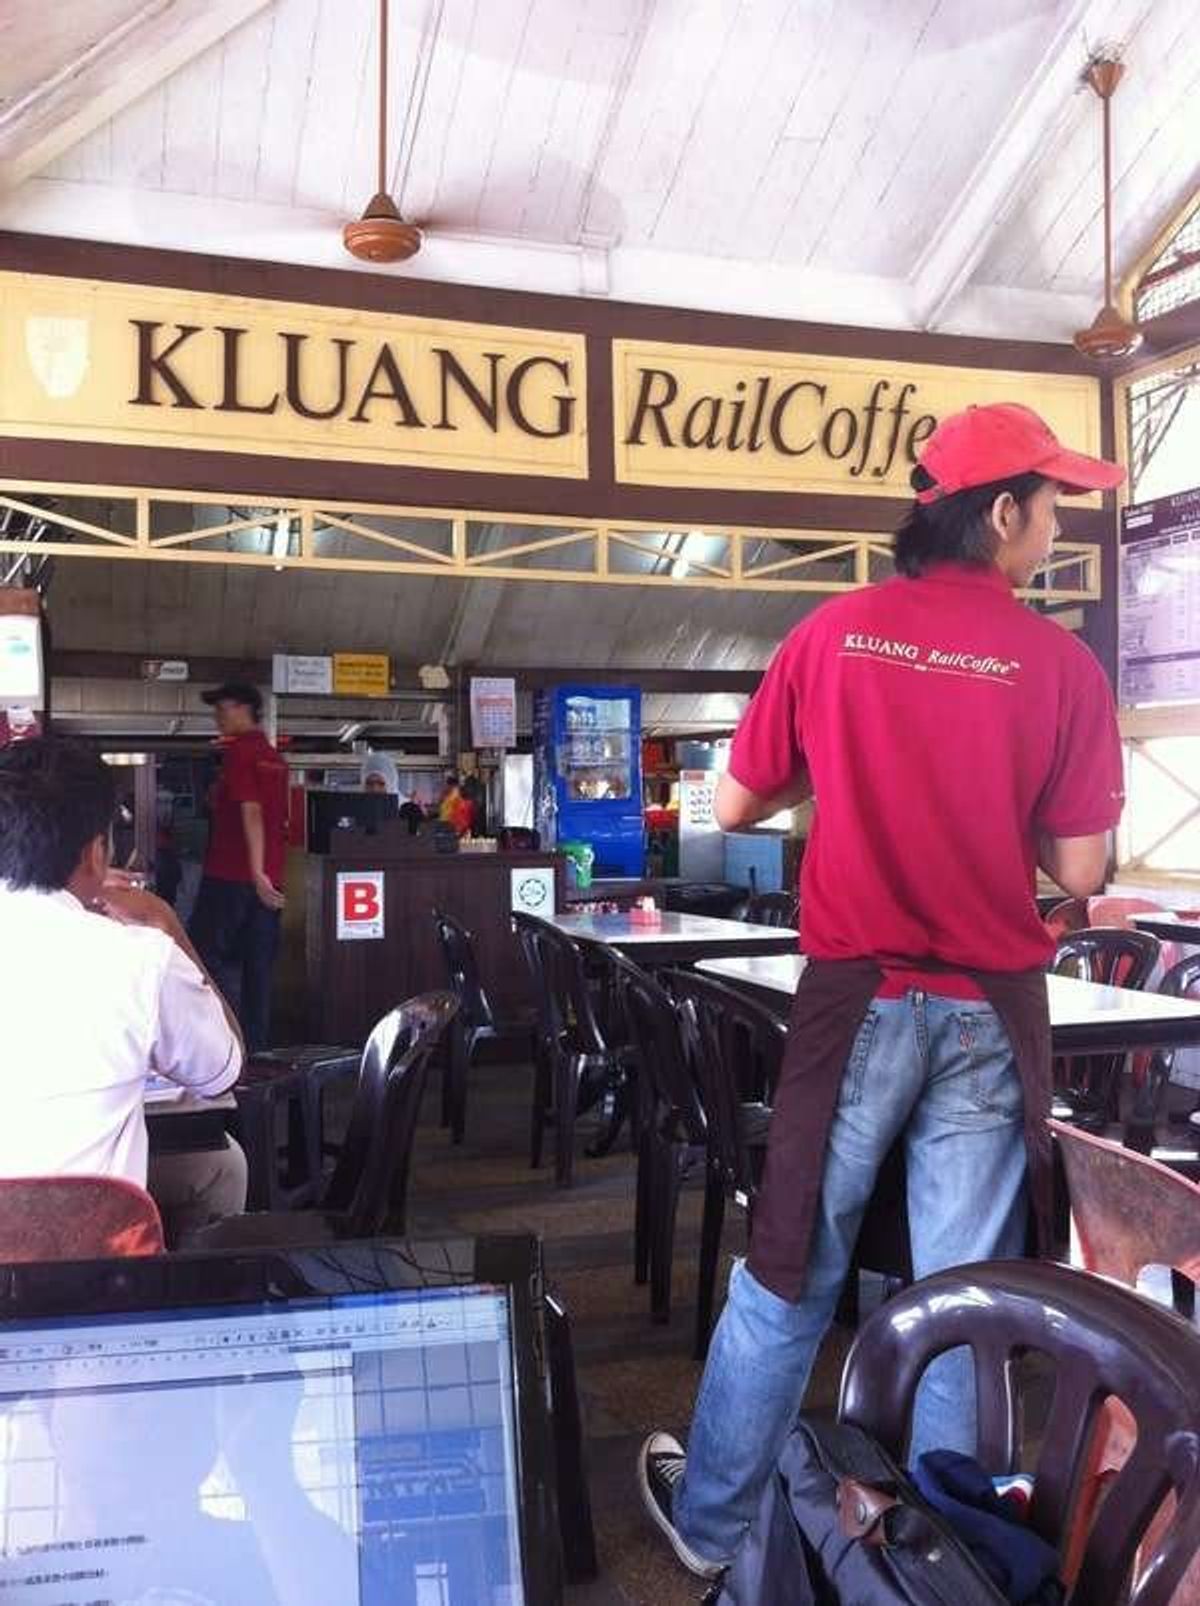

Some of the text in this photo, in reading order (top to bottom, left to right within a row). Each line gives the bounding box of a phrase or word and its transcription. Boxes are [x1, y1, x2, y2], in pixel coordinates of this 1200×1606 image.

[128, 319, 937, 477] KLUANG RailCoffe
[844, 634, 919, 660] KLUANG
[345, 882, 379, 920] B
